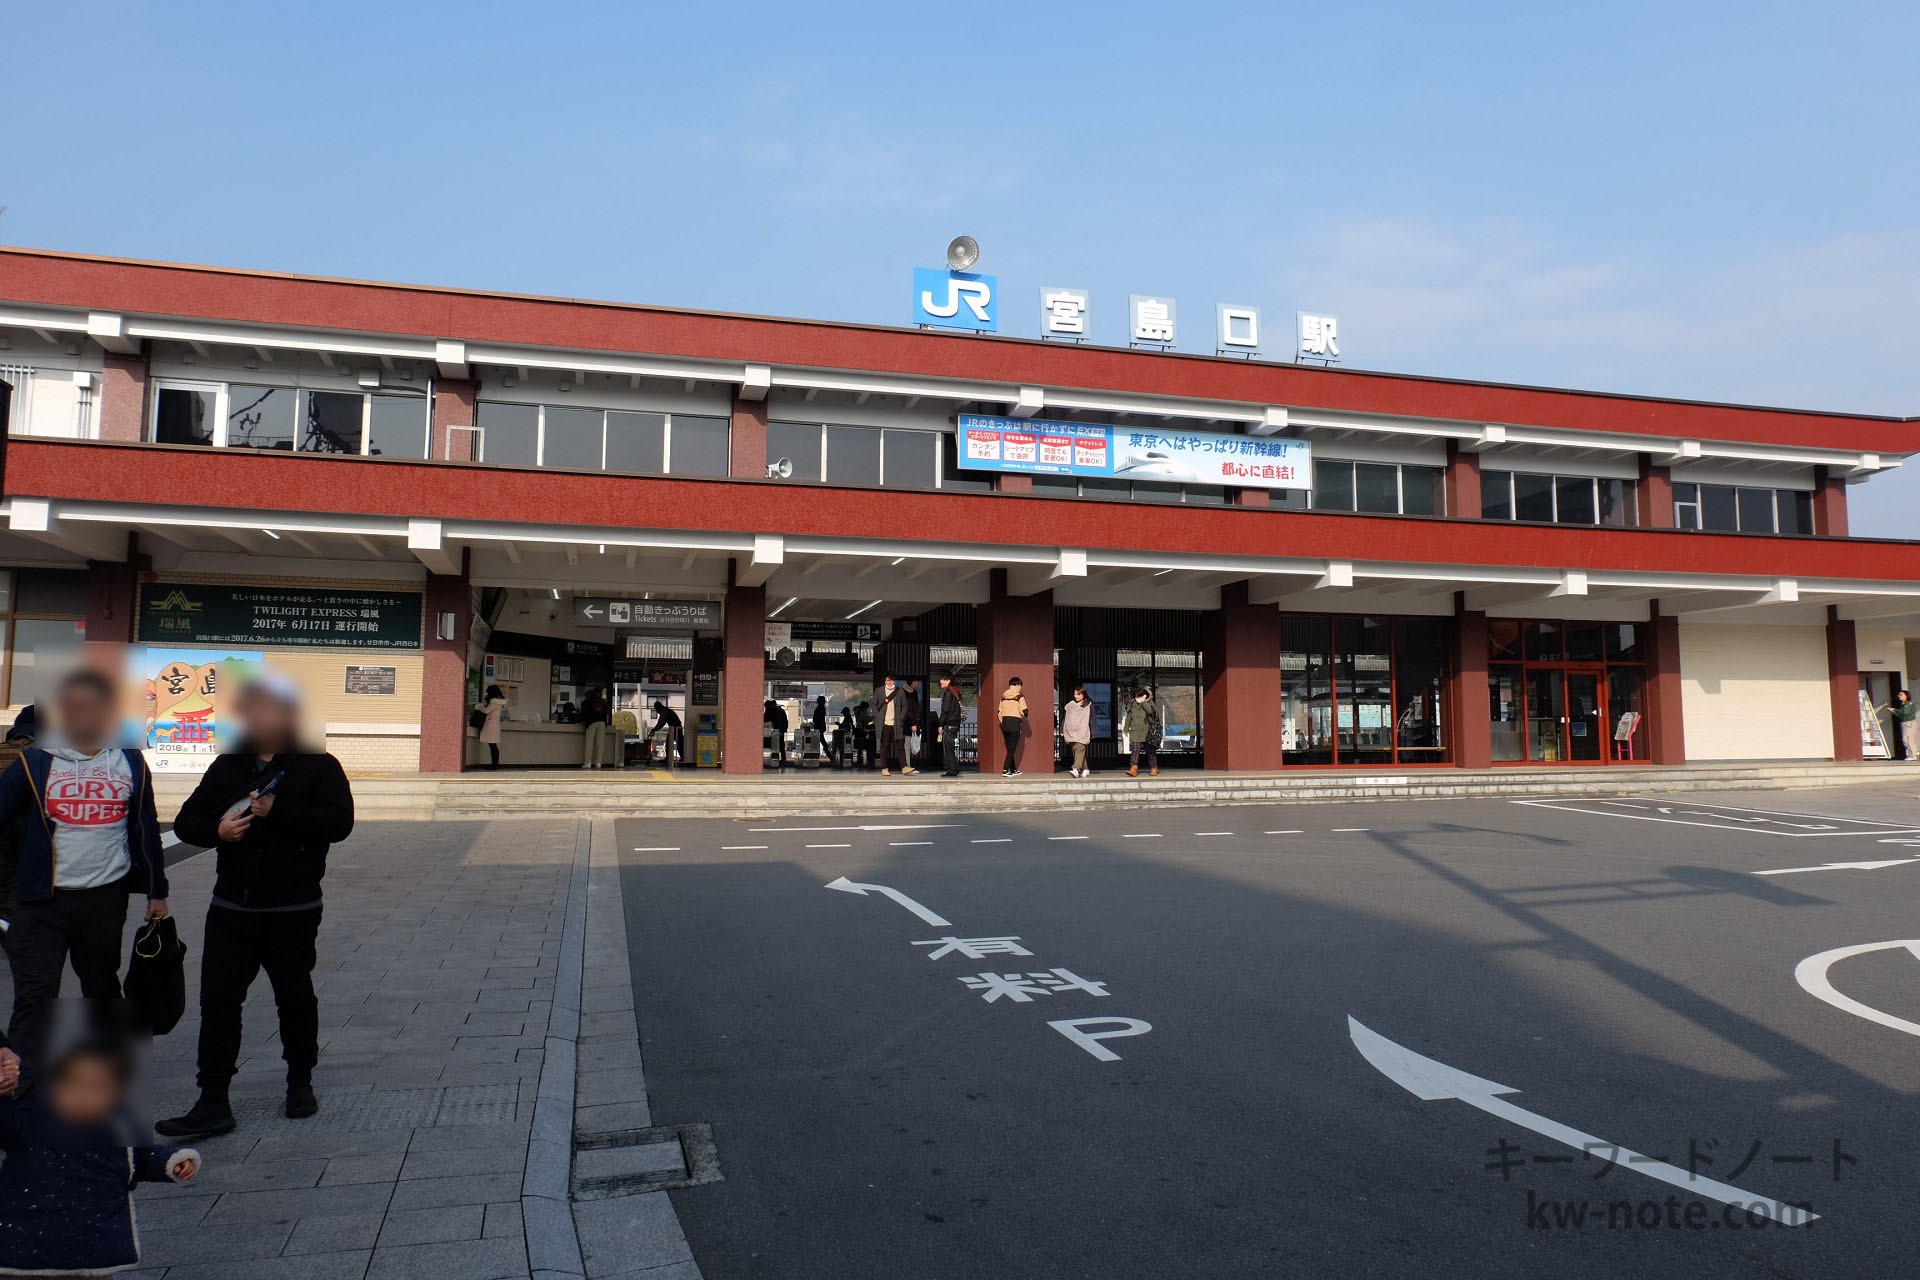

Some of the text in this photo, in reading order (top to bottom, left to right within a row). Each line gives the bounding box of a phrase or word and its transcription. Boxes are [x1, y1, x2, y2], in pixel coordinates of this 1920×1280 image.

[921, 279, 1341, 356] JR 宮島口駅
[978, 450, 991, 458] 予約
[1004, 445, 1034, 453] シートマップ
[1221, 461, 1295, 480] 都心に直結!
[253, 606, 308, 616] TWILIGHT
[311, 608, 358, 618] EXPRESS
[634, 605, 707, 615] 自動きっぷうりば
[635, 615, 657, 623] Tickets
[252, 619, 379, 632] 2017年 6月17日 運行開始
[60, 781, 124, 799] DRY
[56, 803, 124, 820] SUPER
